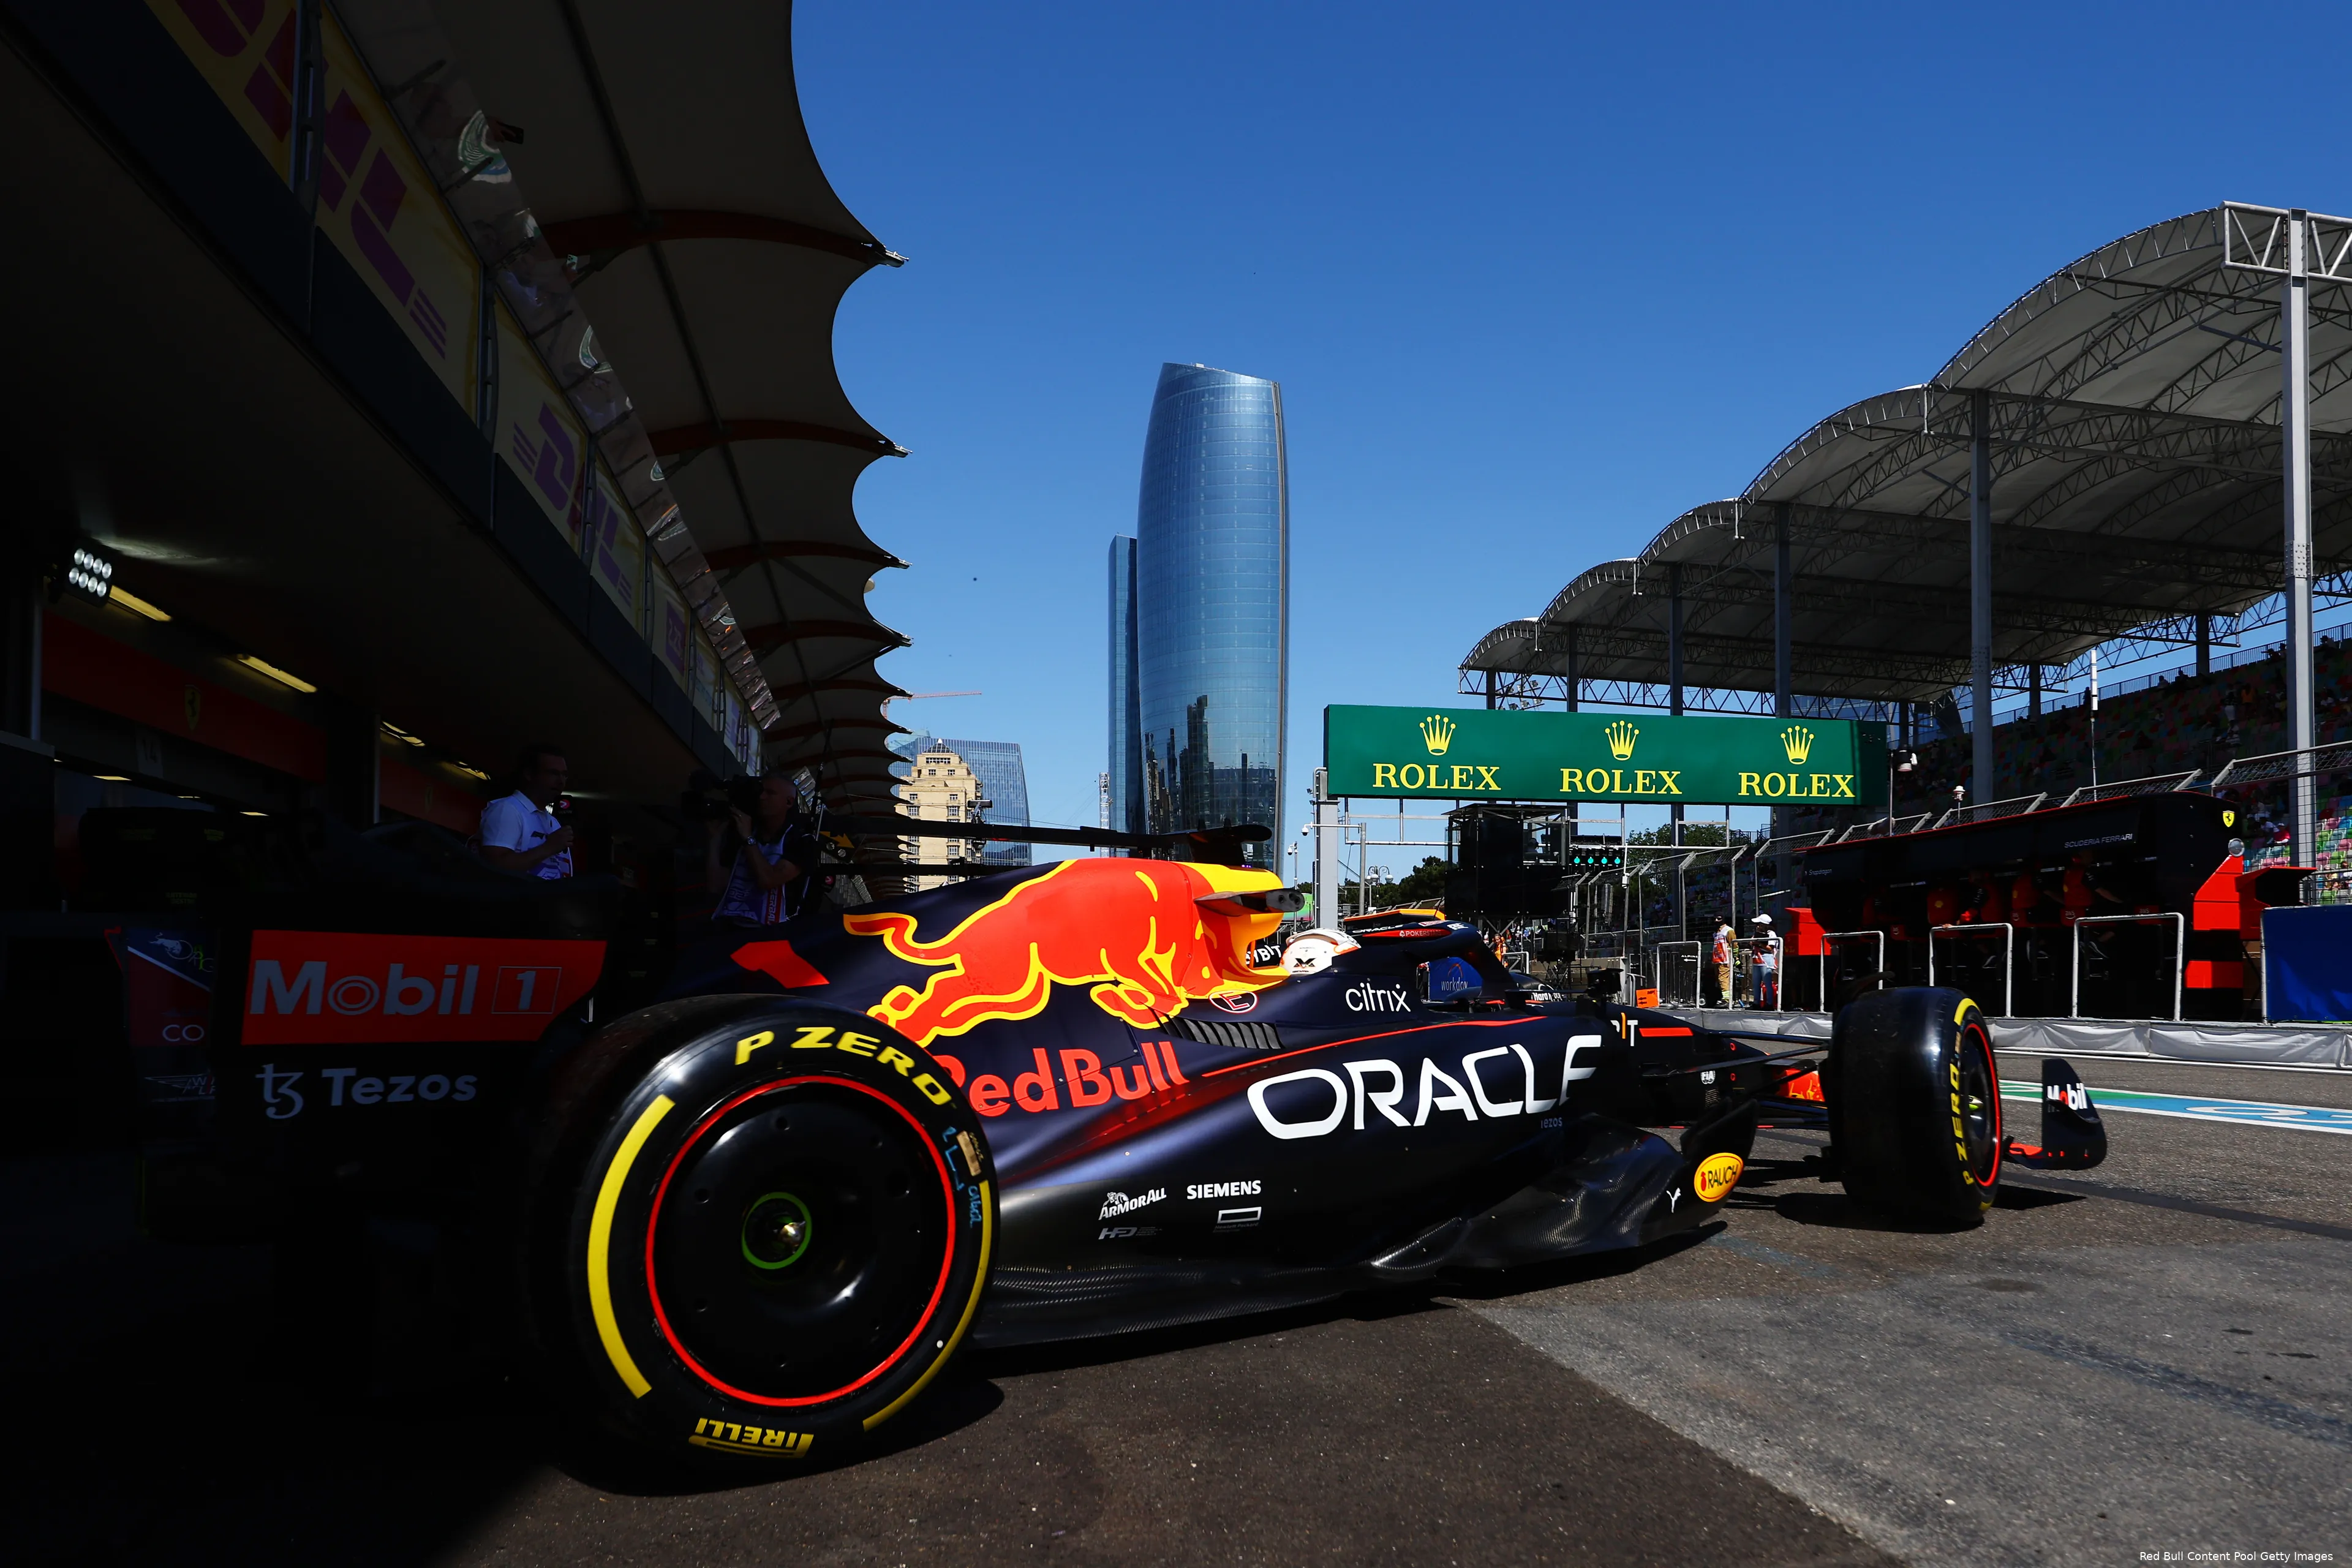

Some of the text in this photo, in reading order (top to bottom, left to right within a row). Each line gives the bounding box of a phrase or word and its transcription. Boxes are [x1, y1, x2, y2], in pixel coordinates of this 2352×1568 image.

[1372, 763, 1502, 791] ROLEX
[1559, 767, 1683, 794] ROLEX
[1738, 771, 1855, 798] ROLEX
[2064, 833, 2133, 848] SCUDERIA FERRARI
[1352, 924, 1404, 933] ORACLE
[249, 959, 537, 1017] Mobil 1
[1345, 982, 1411, 1012] citrix
[734, 1026, 953, 1106] P ZERO
[321, 1068, 479, 1107] Tezos
[1246, 1034, 1602, 1140] ORACLE
[1949, 1063, 1975, 1185] P ZERO
[1186, 1180, 1262, 1200] SIEMENS
[1708, 1164, 1738, 1189] RAUCH
[687, 1416, 815, 1459] PIRELLI
